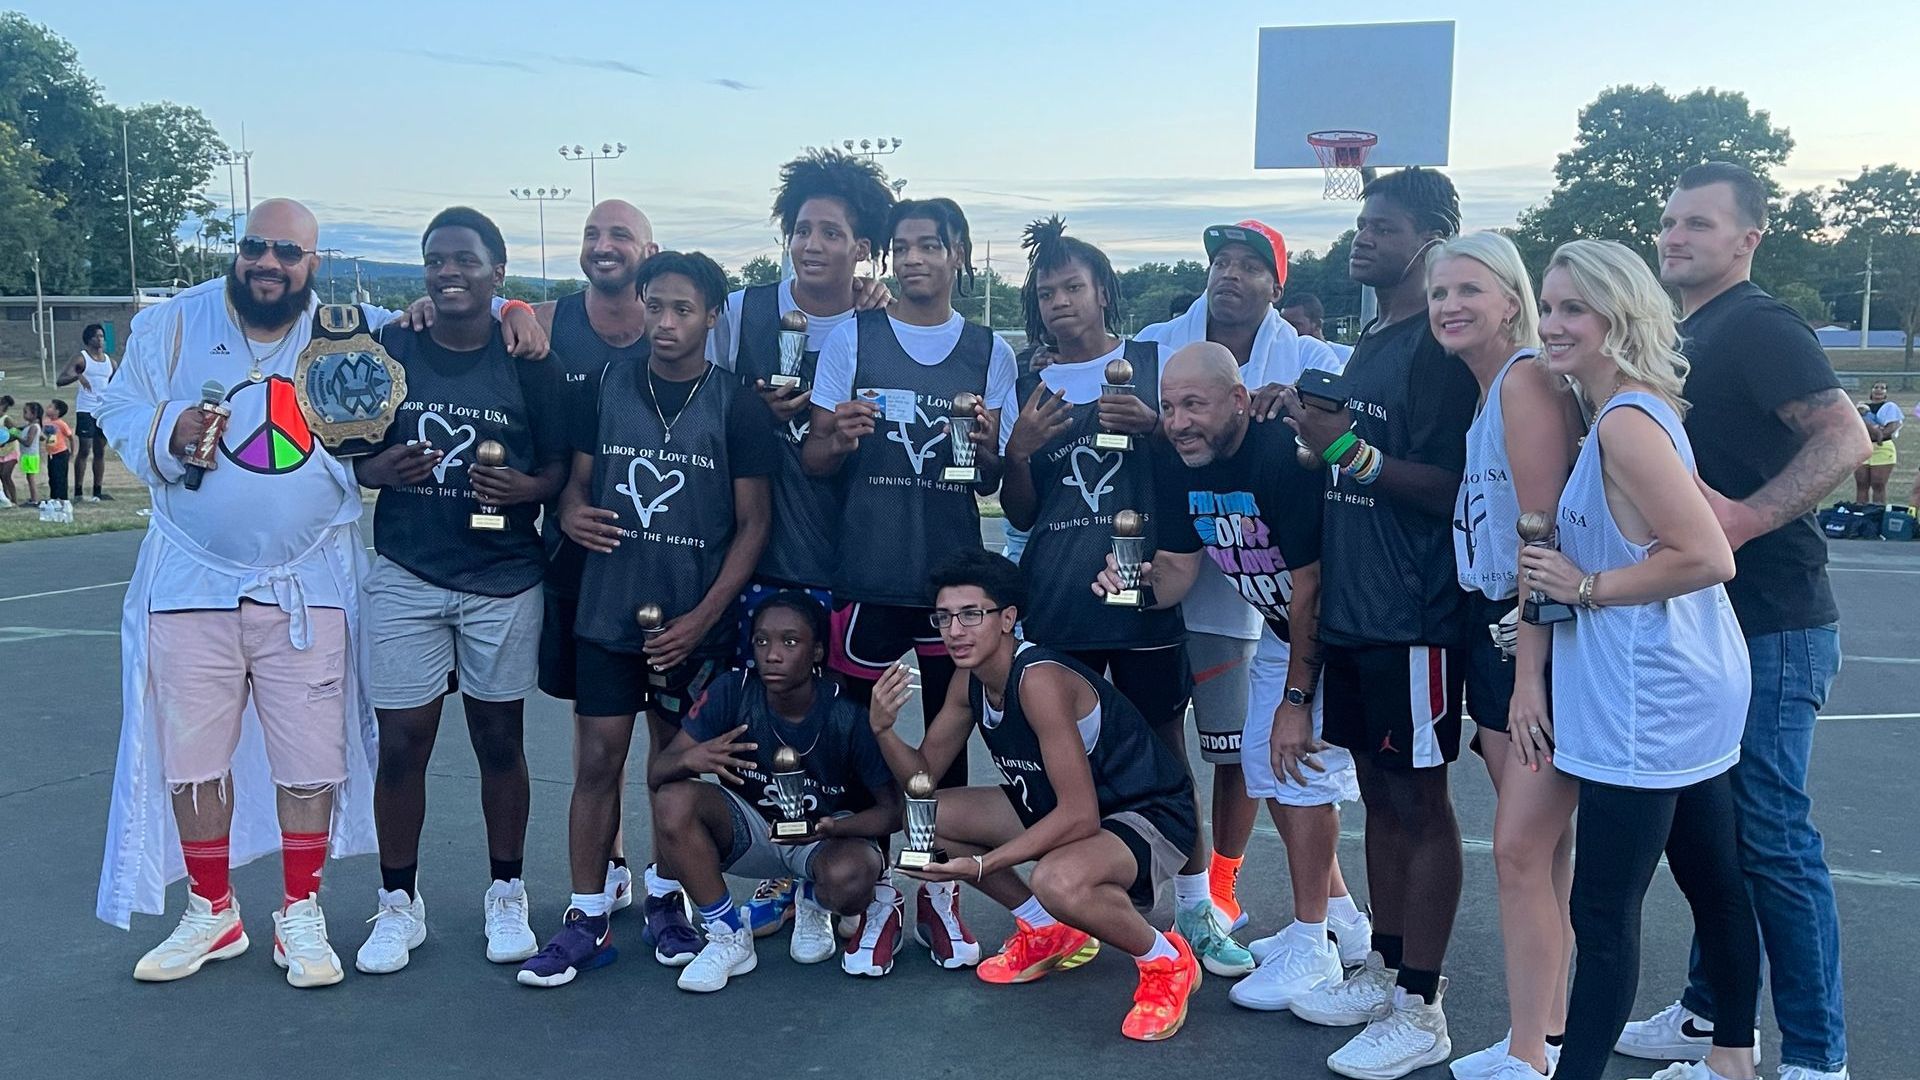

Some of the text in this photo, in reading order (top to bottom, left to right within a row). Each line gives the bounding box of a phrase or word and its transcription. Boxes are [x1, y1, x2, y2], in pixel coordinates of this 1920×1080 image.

[566, 373, 588, 382] LAB
[400, 401, 508, 424] BOR OF LOVE USA
[1078, 435, 1092, 445] OF
[602, 444, 715, 469] LABOR OF LOVE USA
[869, 476, 912, 486] TURNING
[916, 478, 932, 488] THE
[438, 487, 457, 497] THE
[1094, 516, 1112, 525] THE
[1562, 507, 1586, 527] USA
[643, 532, 661, 542] THE
[666, 535, 705, 548] HEARTS
[1210, 736, 1228, 750] DO
[1228, 735, 1241, 749] IT
[737, 767, 767, 783] LABOR
